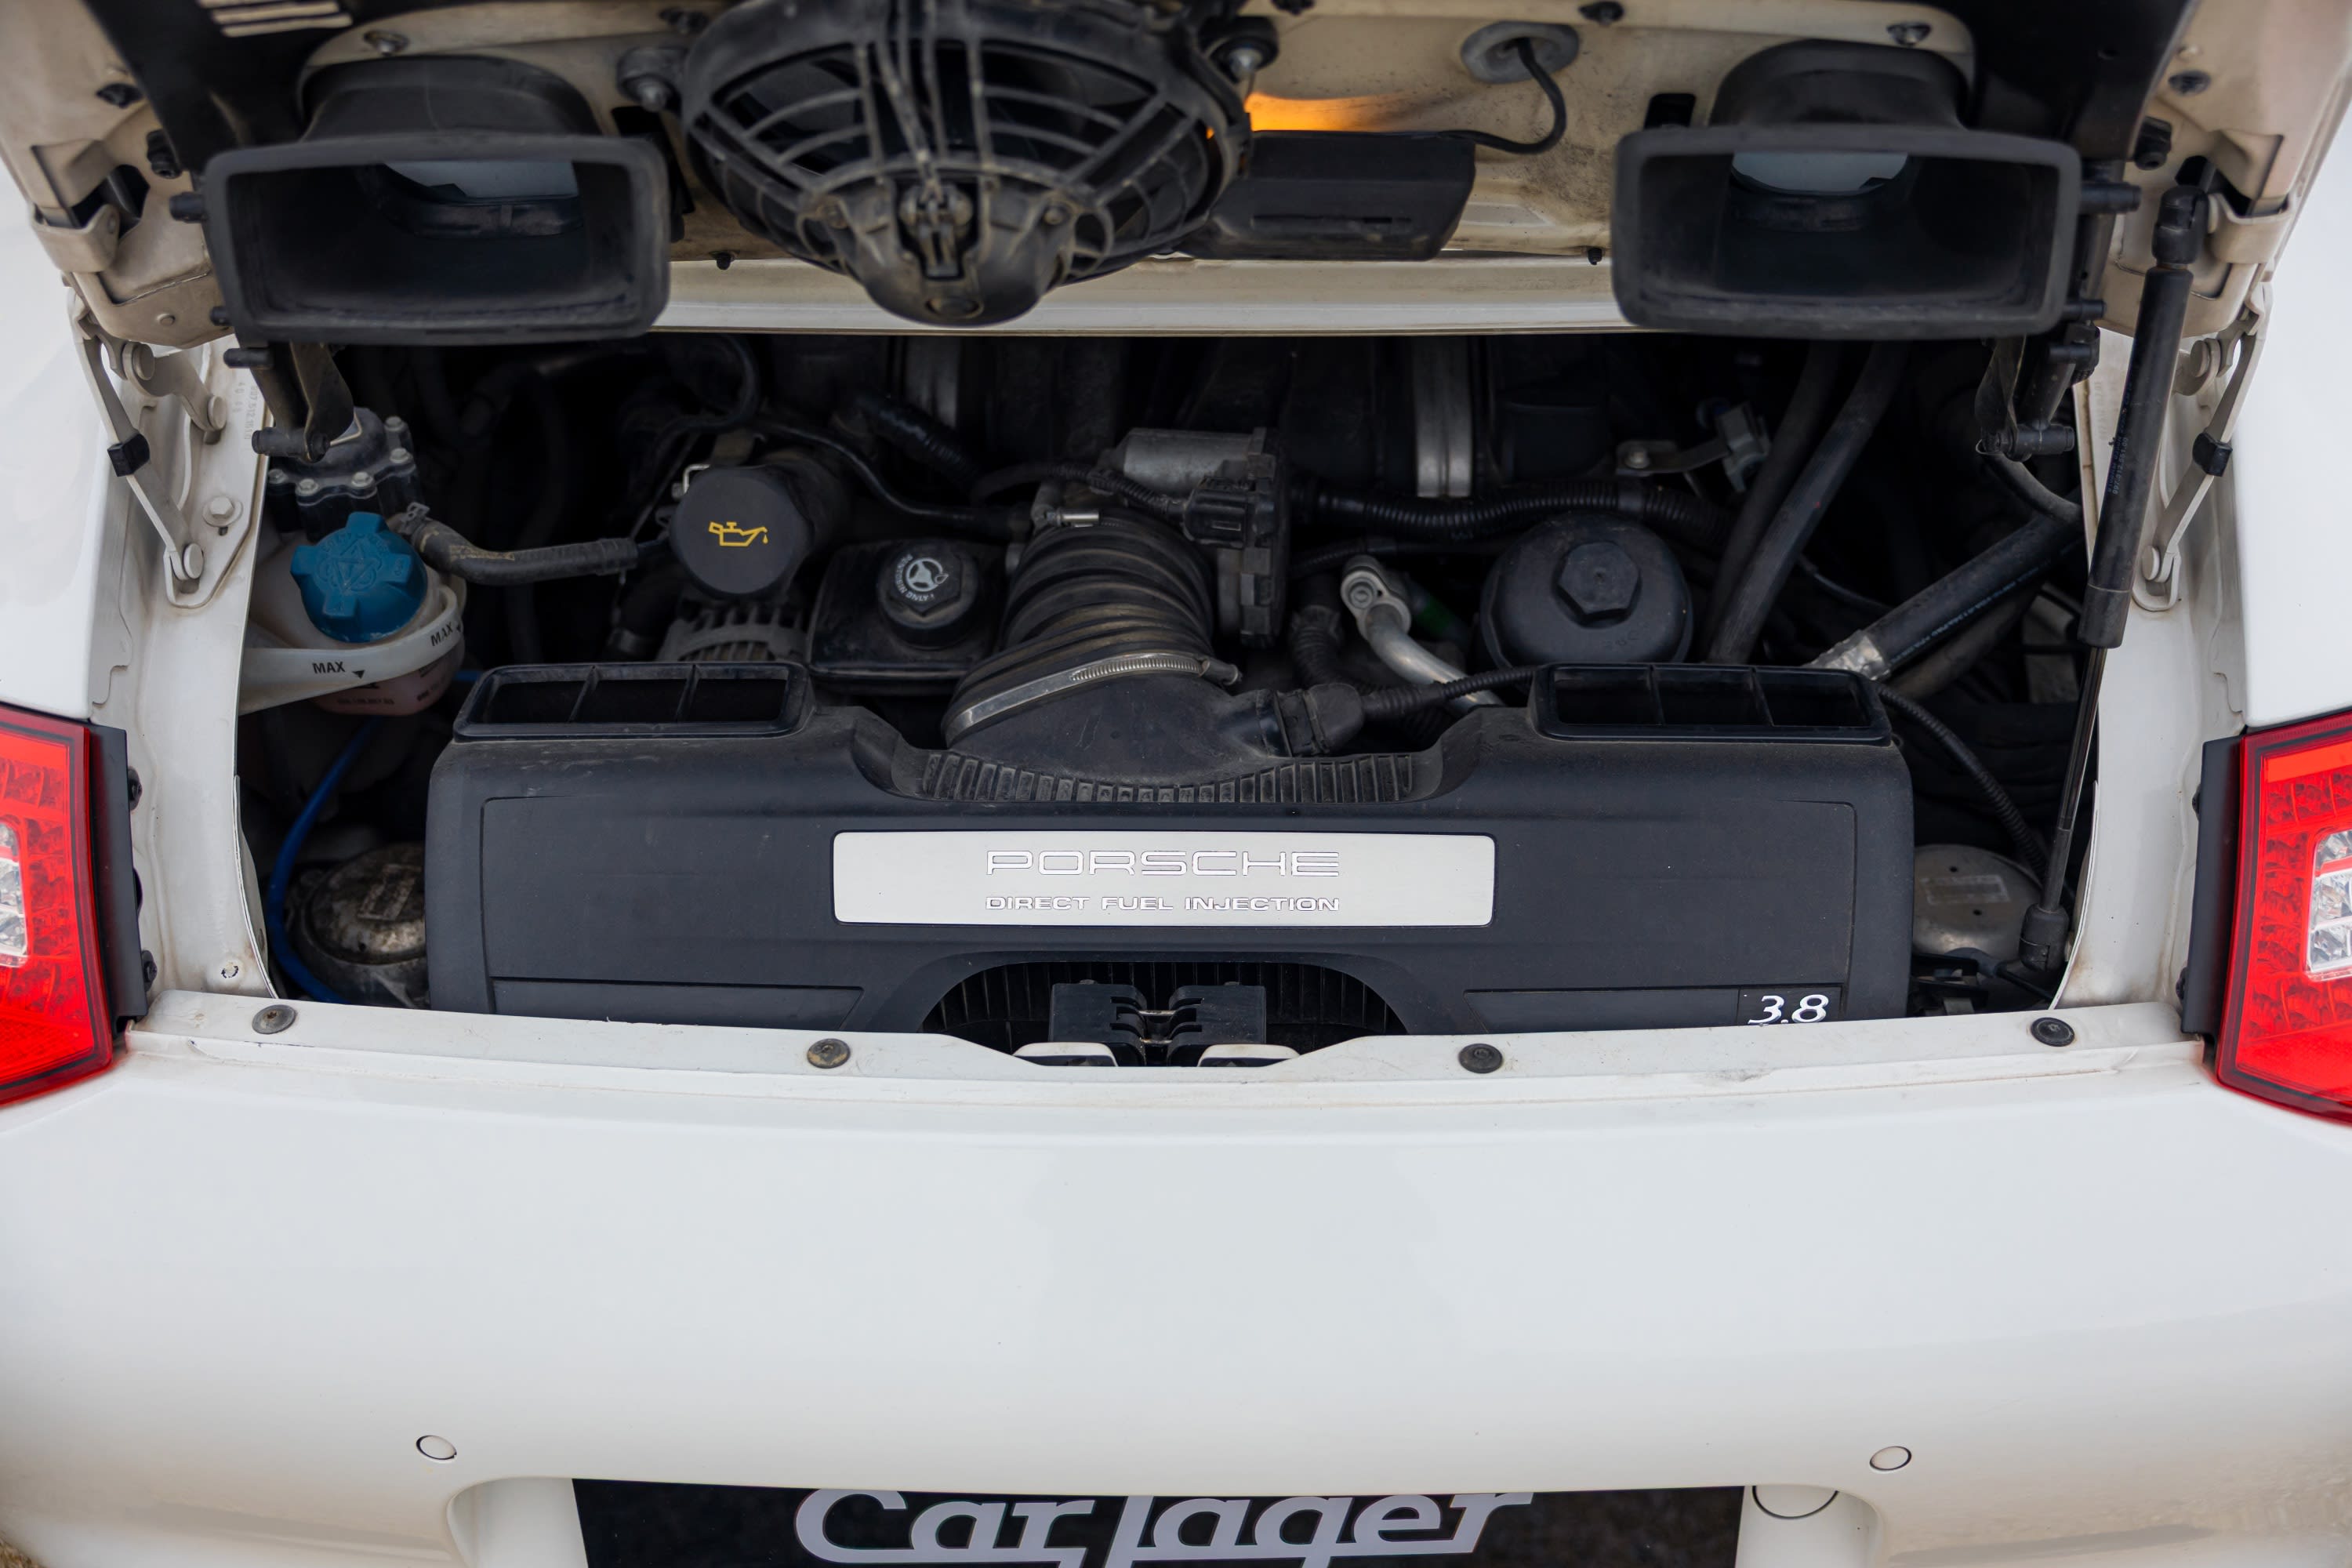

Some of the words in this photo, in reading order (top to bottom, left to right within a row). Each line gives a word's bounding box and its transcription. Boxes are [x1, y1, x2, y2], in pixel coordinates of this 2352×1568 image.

[430, 622, 453, 647] MAX
[312, 661, 346, 674] MAX
[986, 850, 1339, 877] PORSCHE
[985, 896, 1091, 910] DIRECT
[1101, 896, 1174, 911] FUEL
[1185, 896, 1340, 912] INJECTION
[1747, 994, 1829, 1024] 3.8
